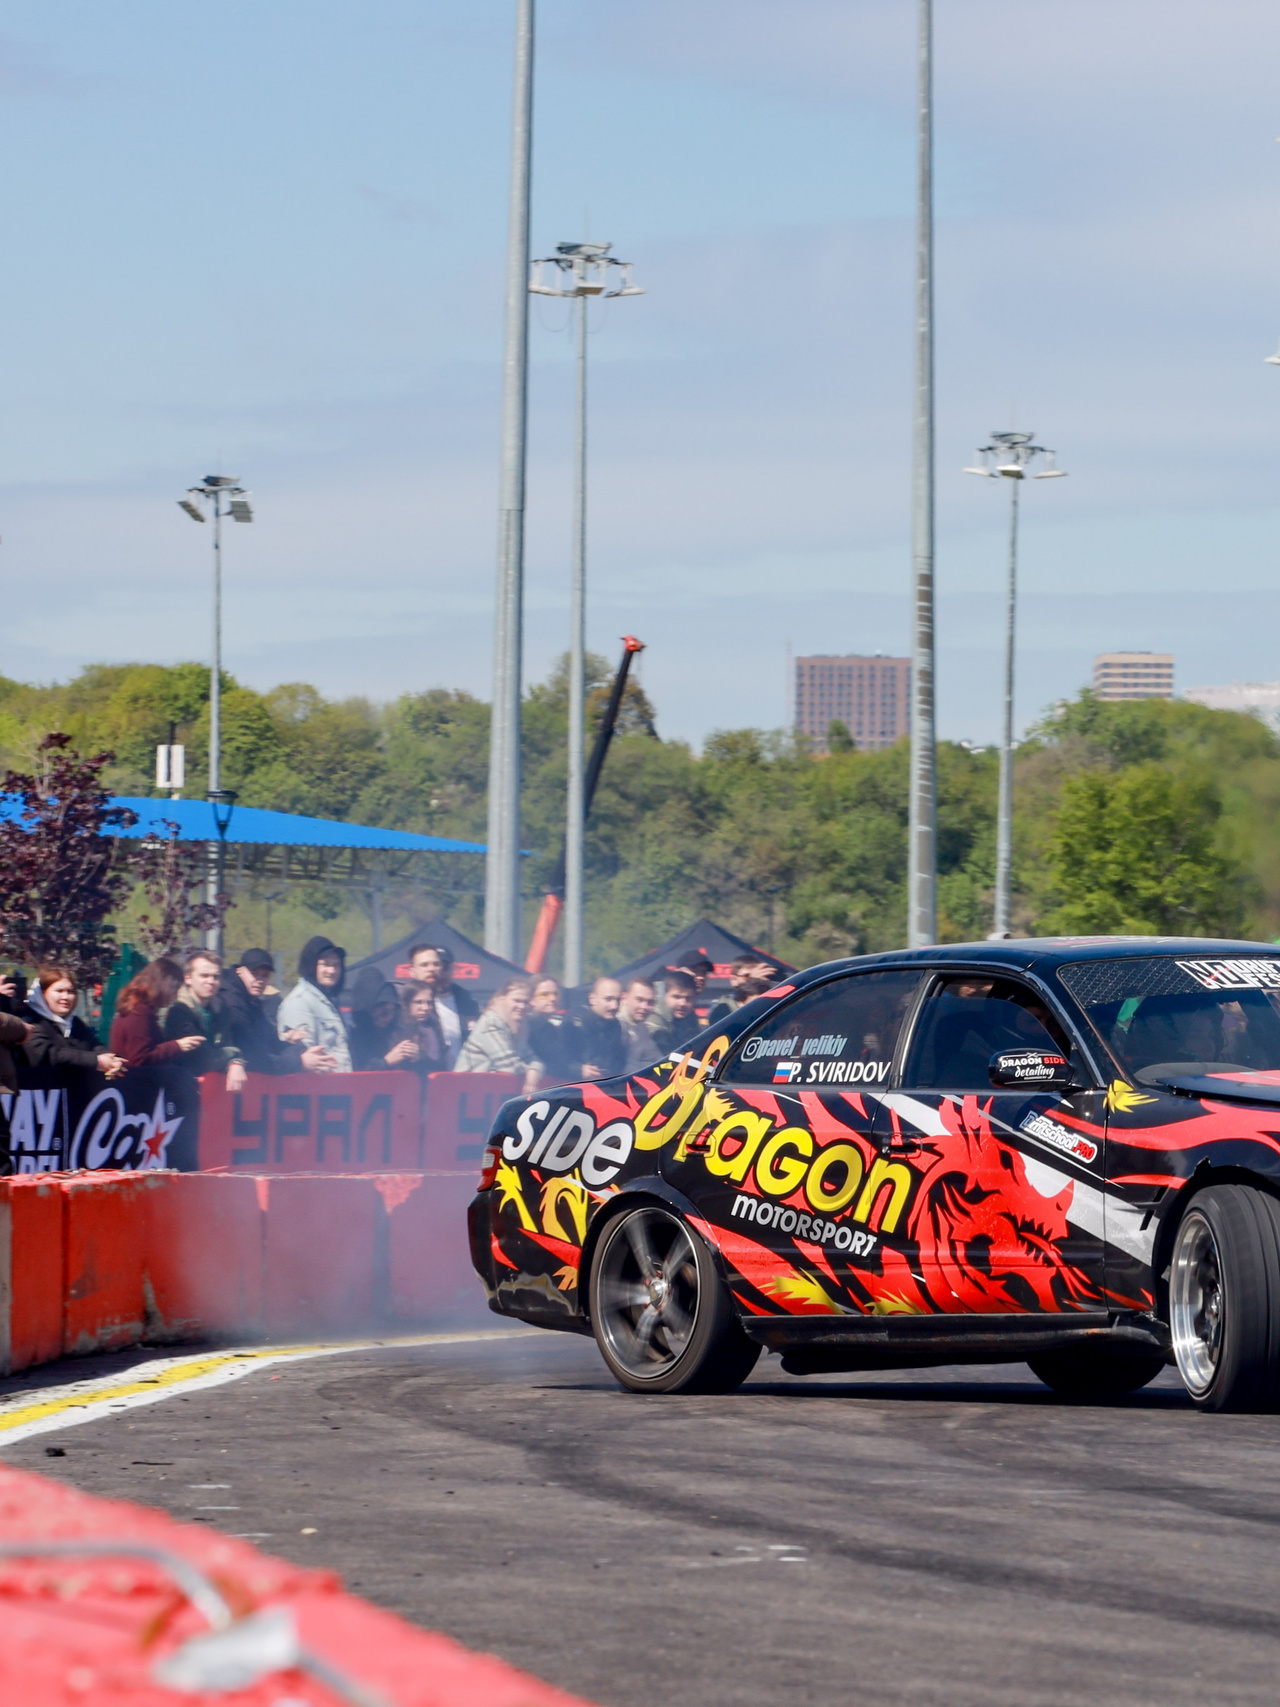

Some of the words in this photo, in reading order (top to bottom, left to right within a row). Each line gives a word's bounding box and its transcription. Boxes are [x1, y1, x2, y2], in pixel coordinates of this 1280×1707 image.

[1001, 1056, 1043, 1068] DRAGON
[1044, 1056, 1066, 1065] SIDE
[788, 1061, 802, 1083] P.
[806, 1061, 892, 1083] SVIRIDOV
[1014, 1064, 1056, 1080] detailing
